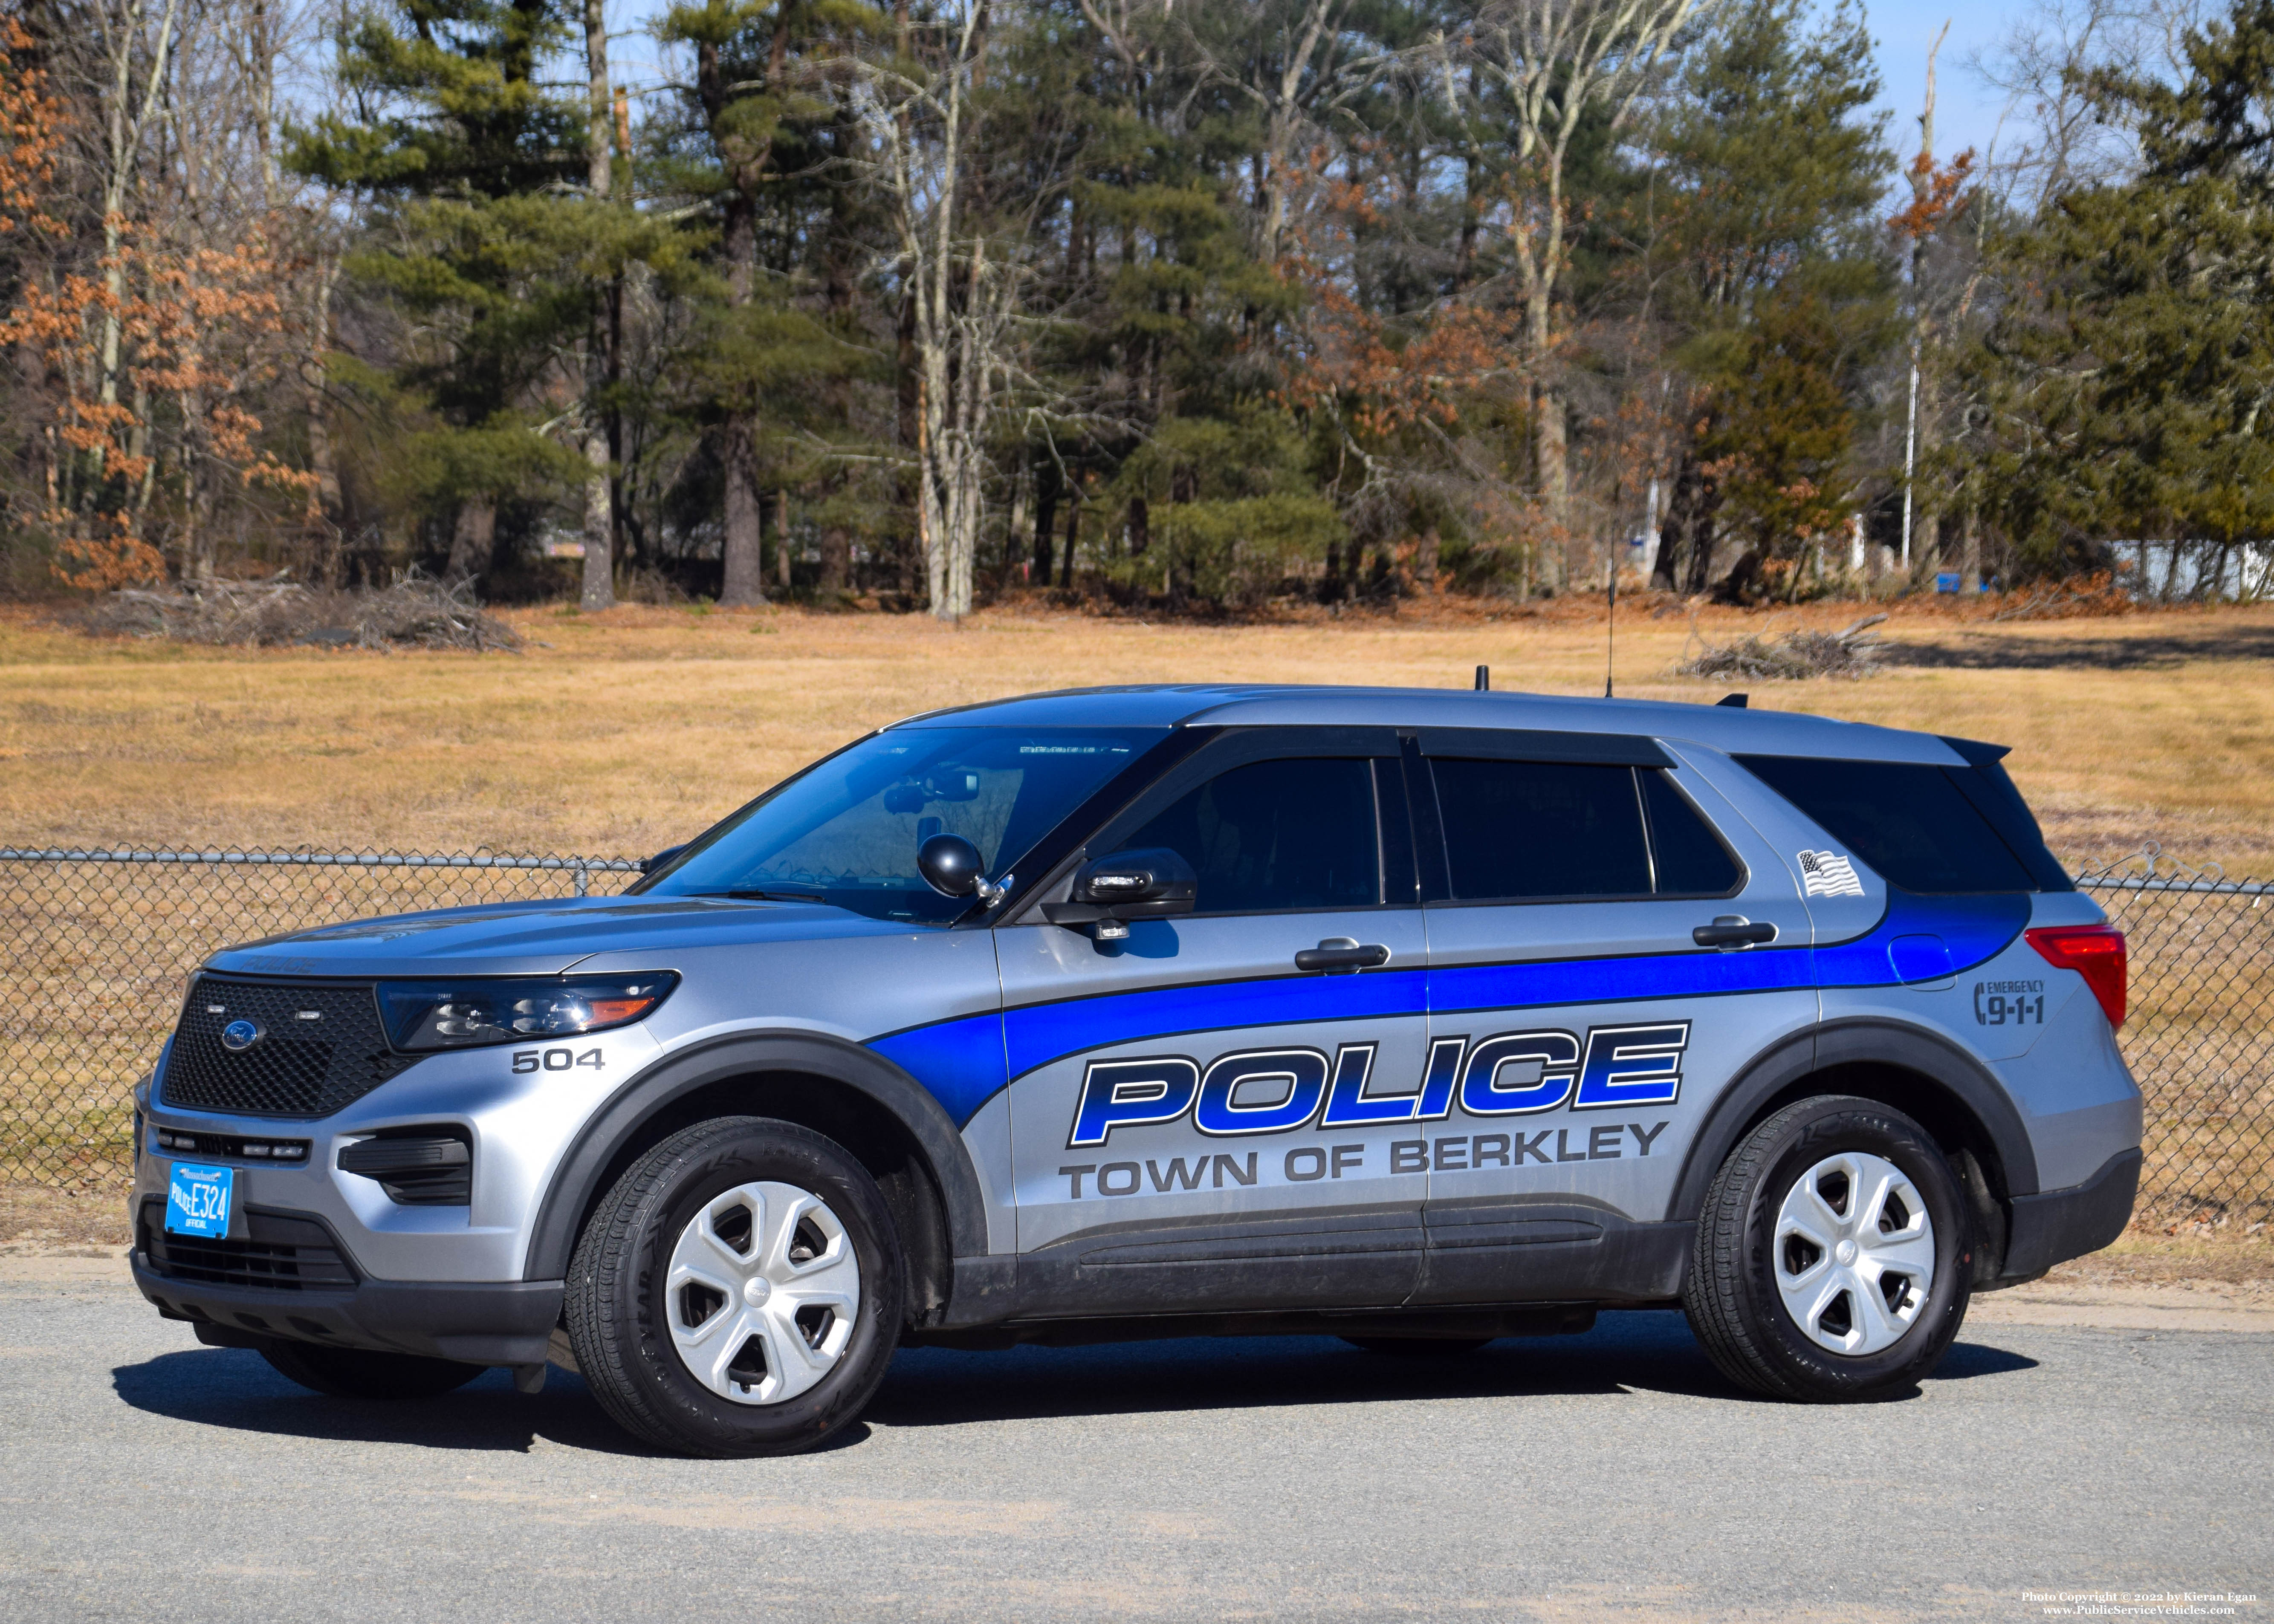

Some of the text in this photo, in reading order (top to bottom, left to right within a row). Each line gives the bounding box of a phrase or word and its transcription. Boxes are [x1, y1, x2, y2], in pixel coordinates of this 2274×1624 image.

[1988, 980, 2045, 994] EMERGENCY
[1988, 995, 2044, 1025] 9-1-1
[512, 1048, 605, 1074] 504
[1065, 1019, 1692, 1150] POLICE
[1058, 1121, 1670, 1199] TOWN OF BERKLEY
[171, 1182, 192, 1215] POLICE
[191, 1183, 227, 1221] E324
[185, 1219, 207, 1229] OFFICIAL
